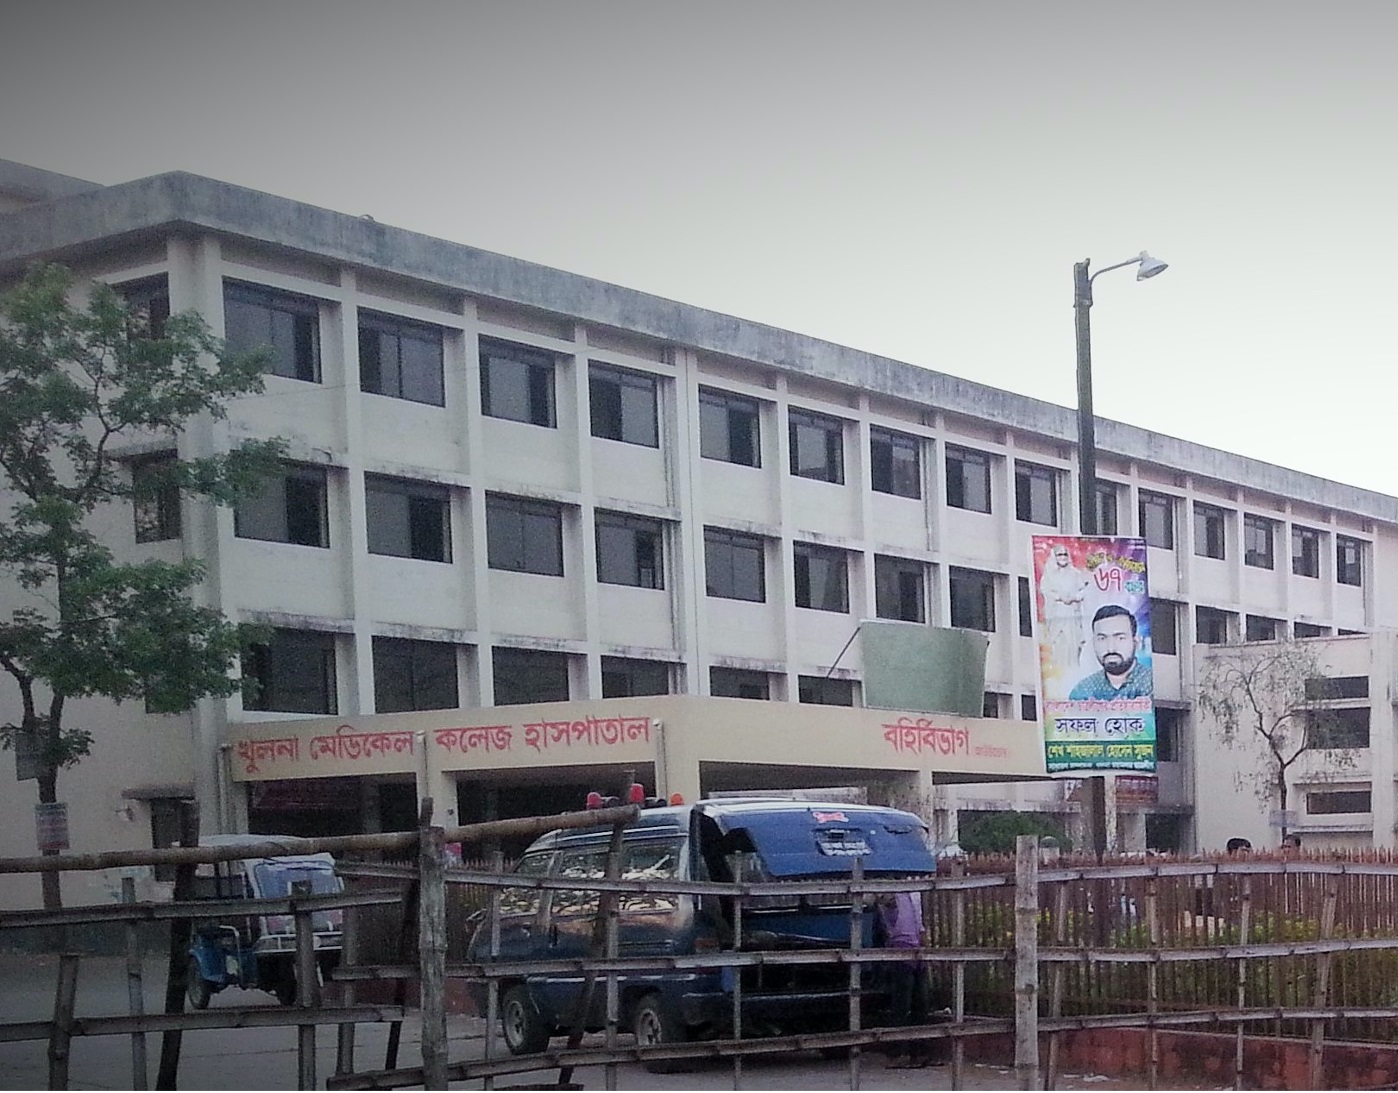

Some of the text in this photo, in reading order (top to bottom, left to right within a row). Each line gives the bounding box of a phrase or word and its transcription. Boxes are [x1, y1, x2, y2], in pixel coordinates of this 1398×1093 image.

[1093, 567, 1121, 592] ৬৭
[881, 716, 970, 756] বহির্বিভাগ
[1054, 717, 1144, 734] সফল হোক
[237, 713, 651, 774] খুলনা মেডিকেল কলেজ হাসপাতাল
